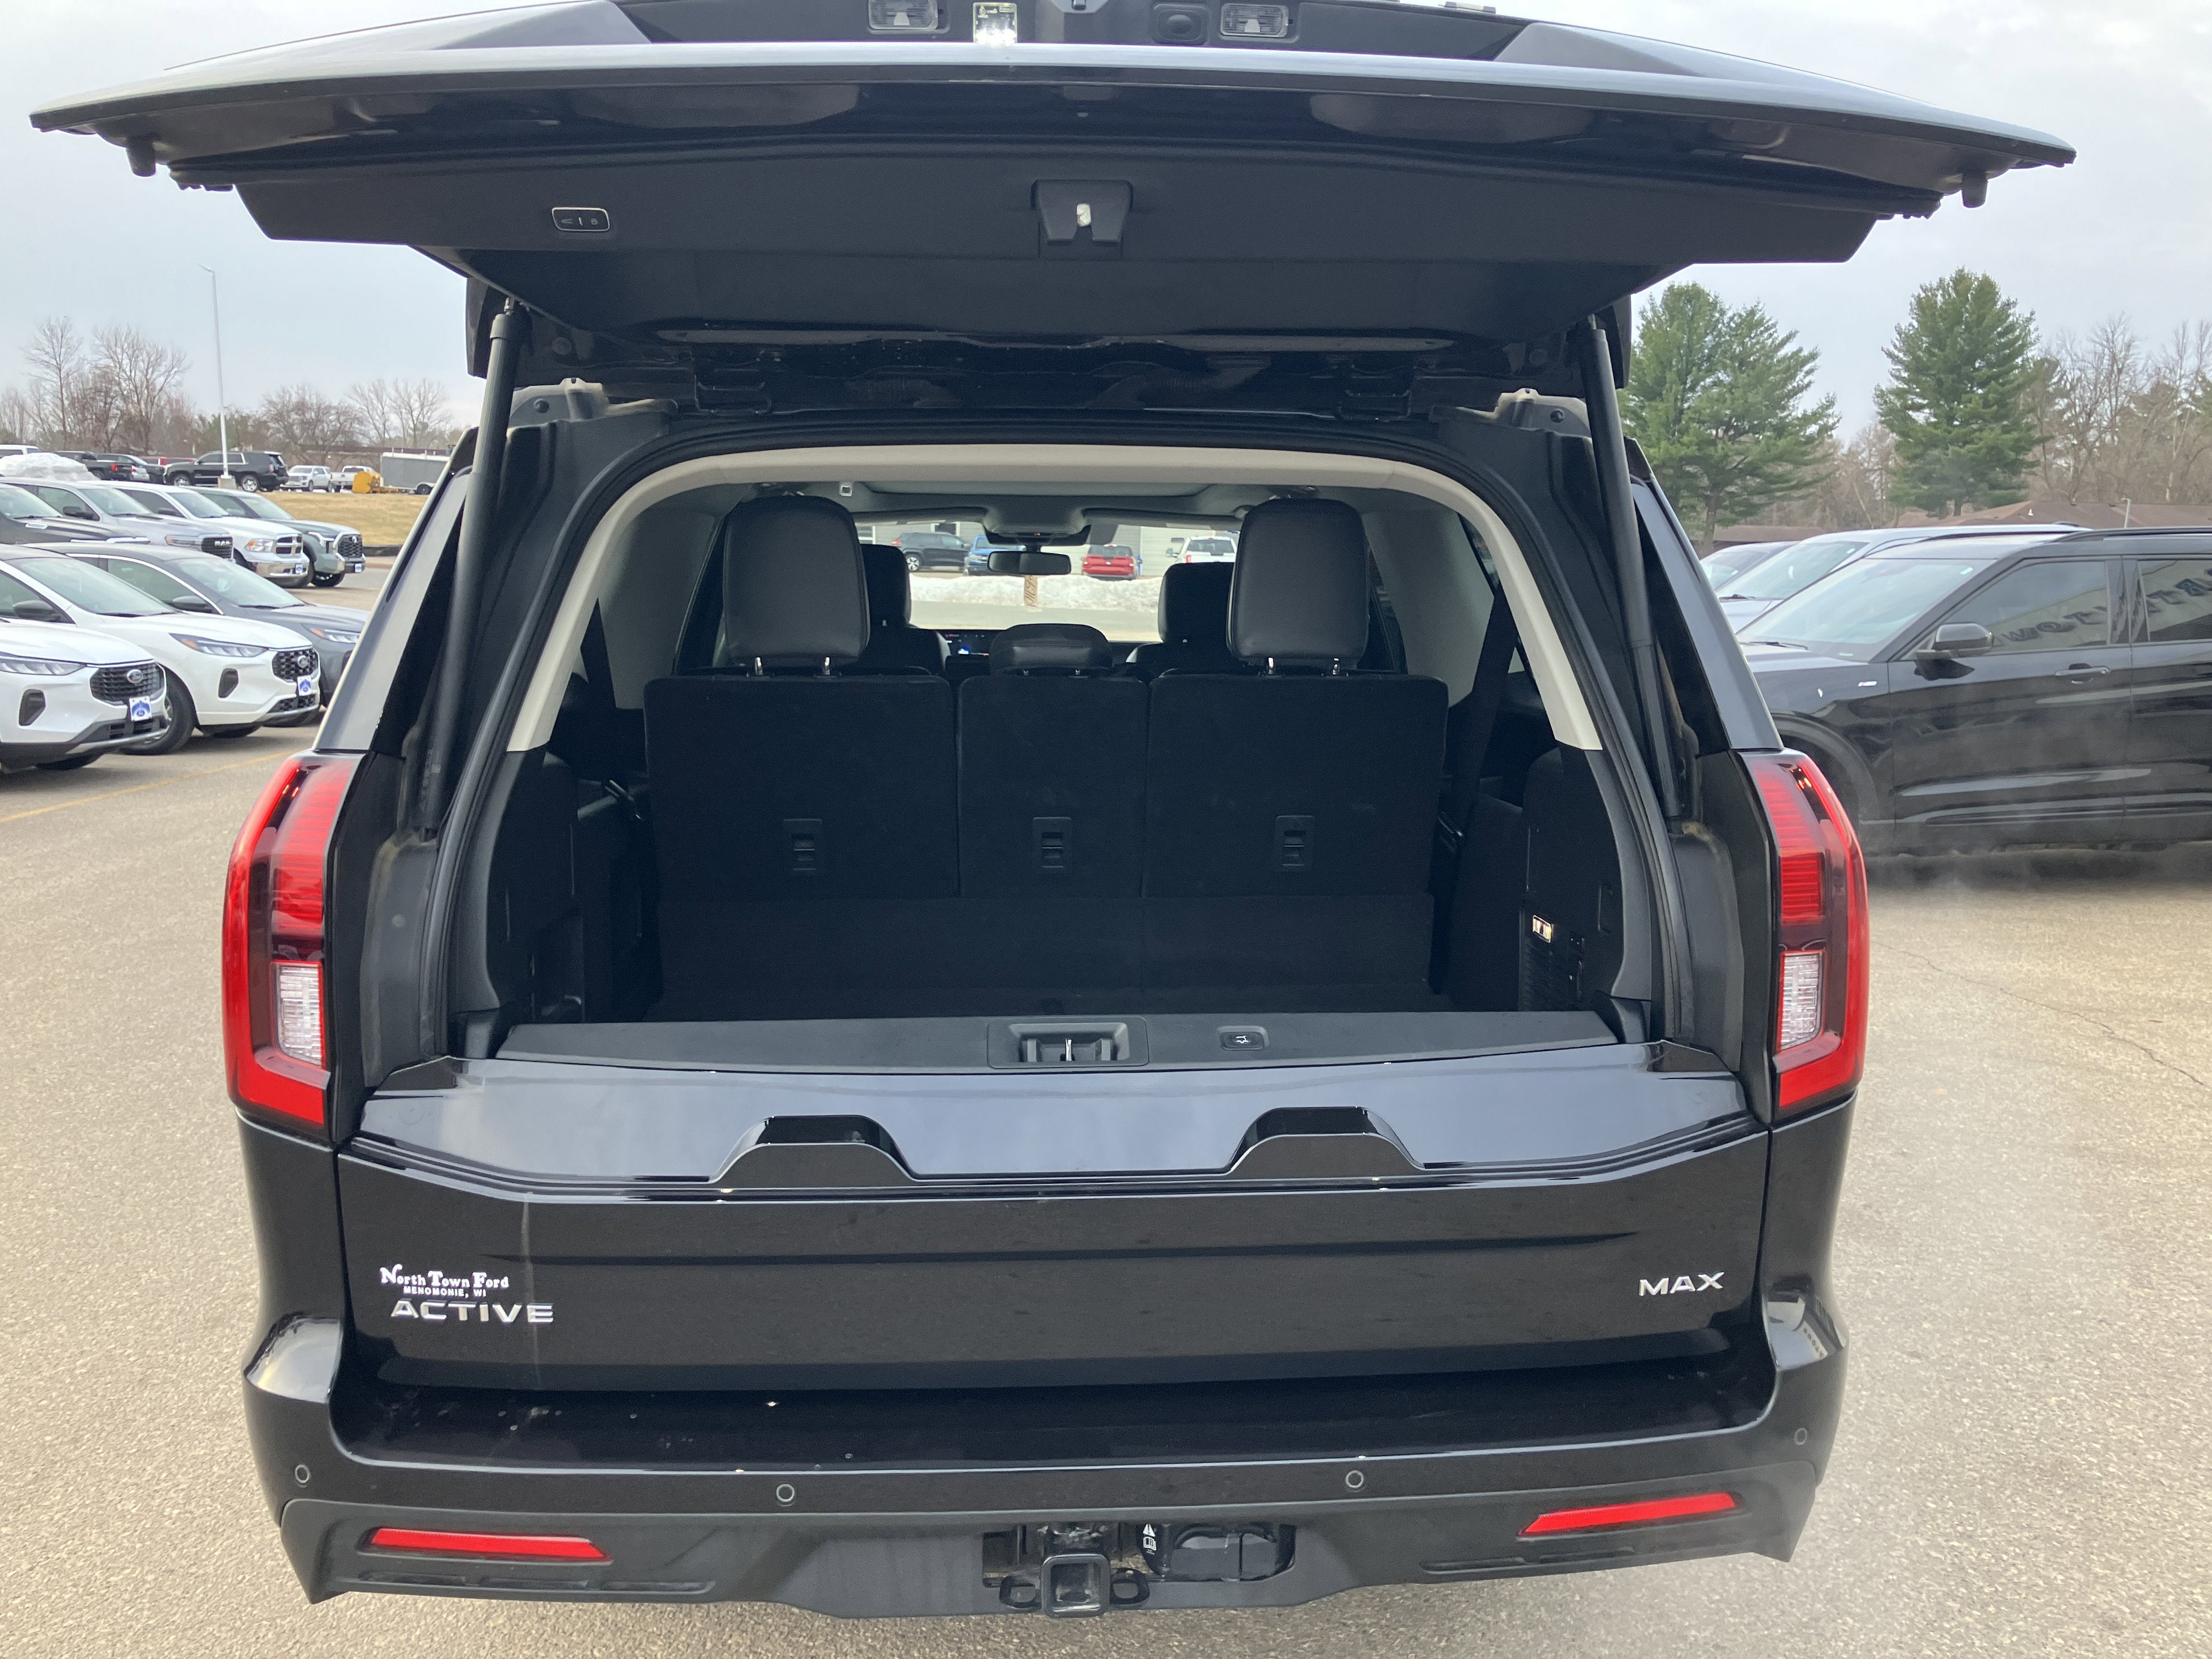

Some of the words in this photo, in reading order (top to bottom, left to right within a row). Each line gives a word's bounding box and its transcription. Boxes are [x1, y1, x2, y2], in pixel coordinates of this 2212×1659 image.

[380, 1263, 426, 1285] North
[428, 1271, 470, 1288] Town
[472, 1272, 509, 1289] Ford
[1638, 1272, 1725, 1296] MAX
[403, 1285, 469, 1299] MENOMONIE,
[473, 1289, 487, 1297] WI
[390, 1299, 554, 1323] ACTIVE
